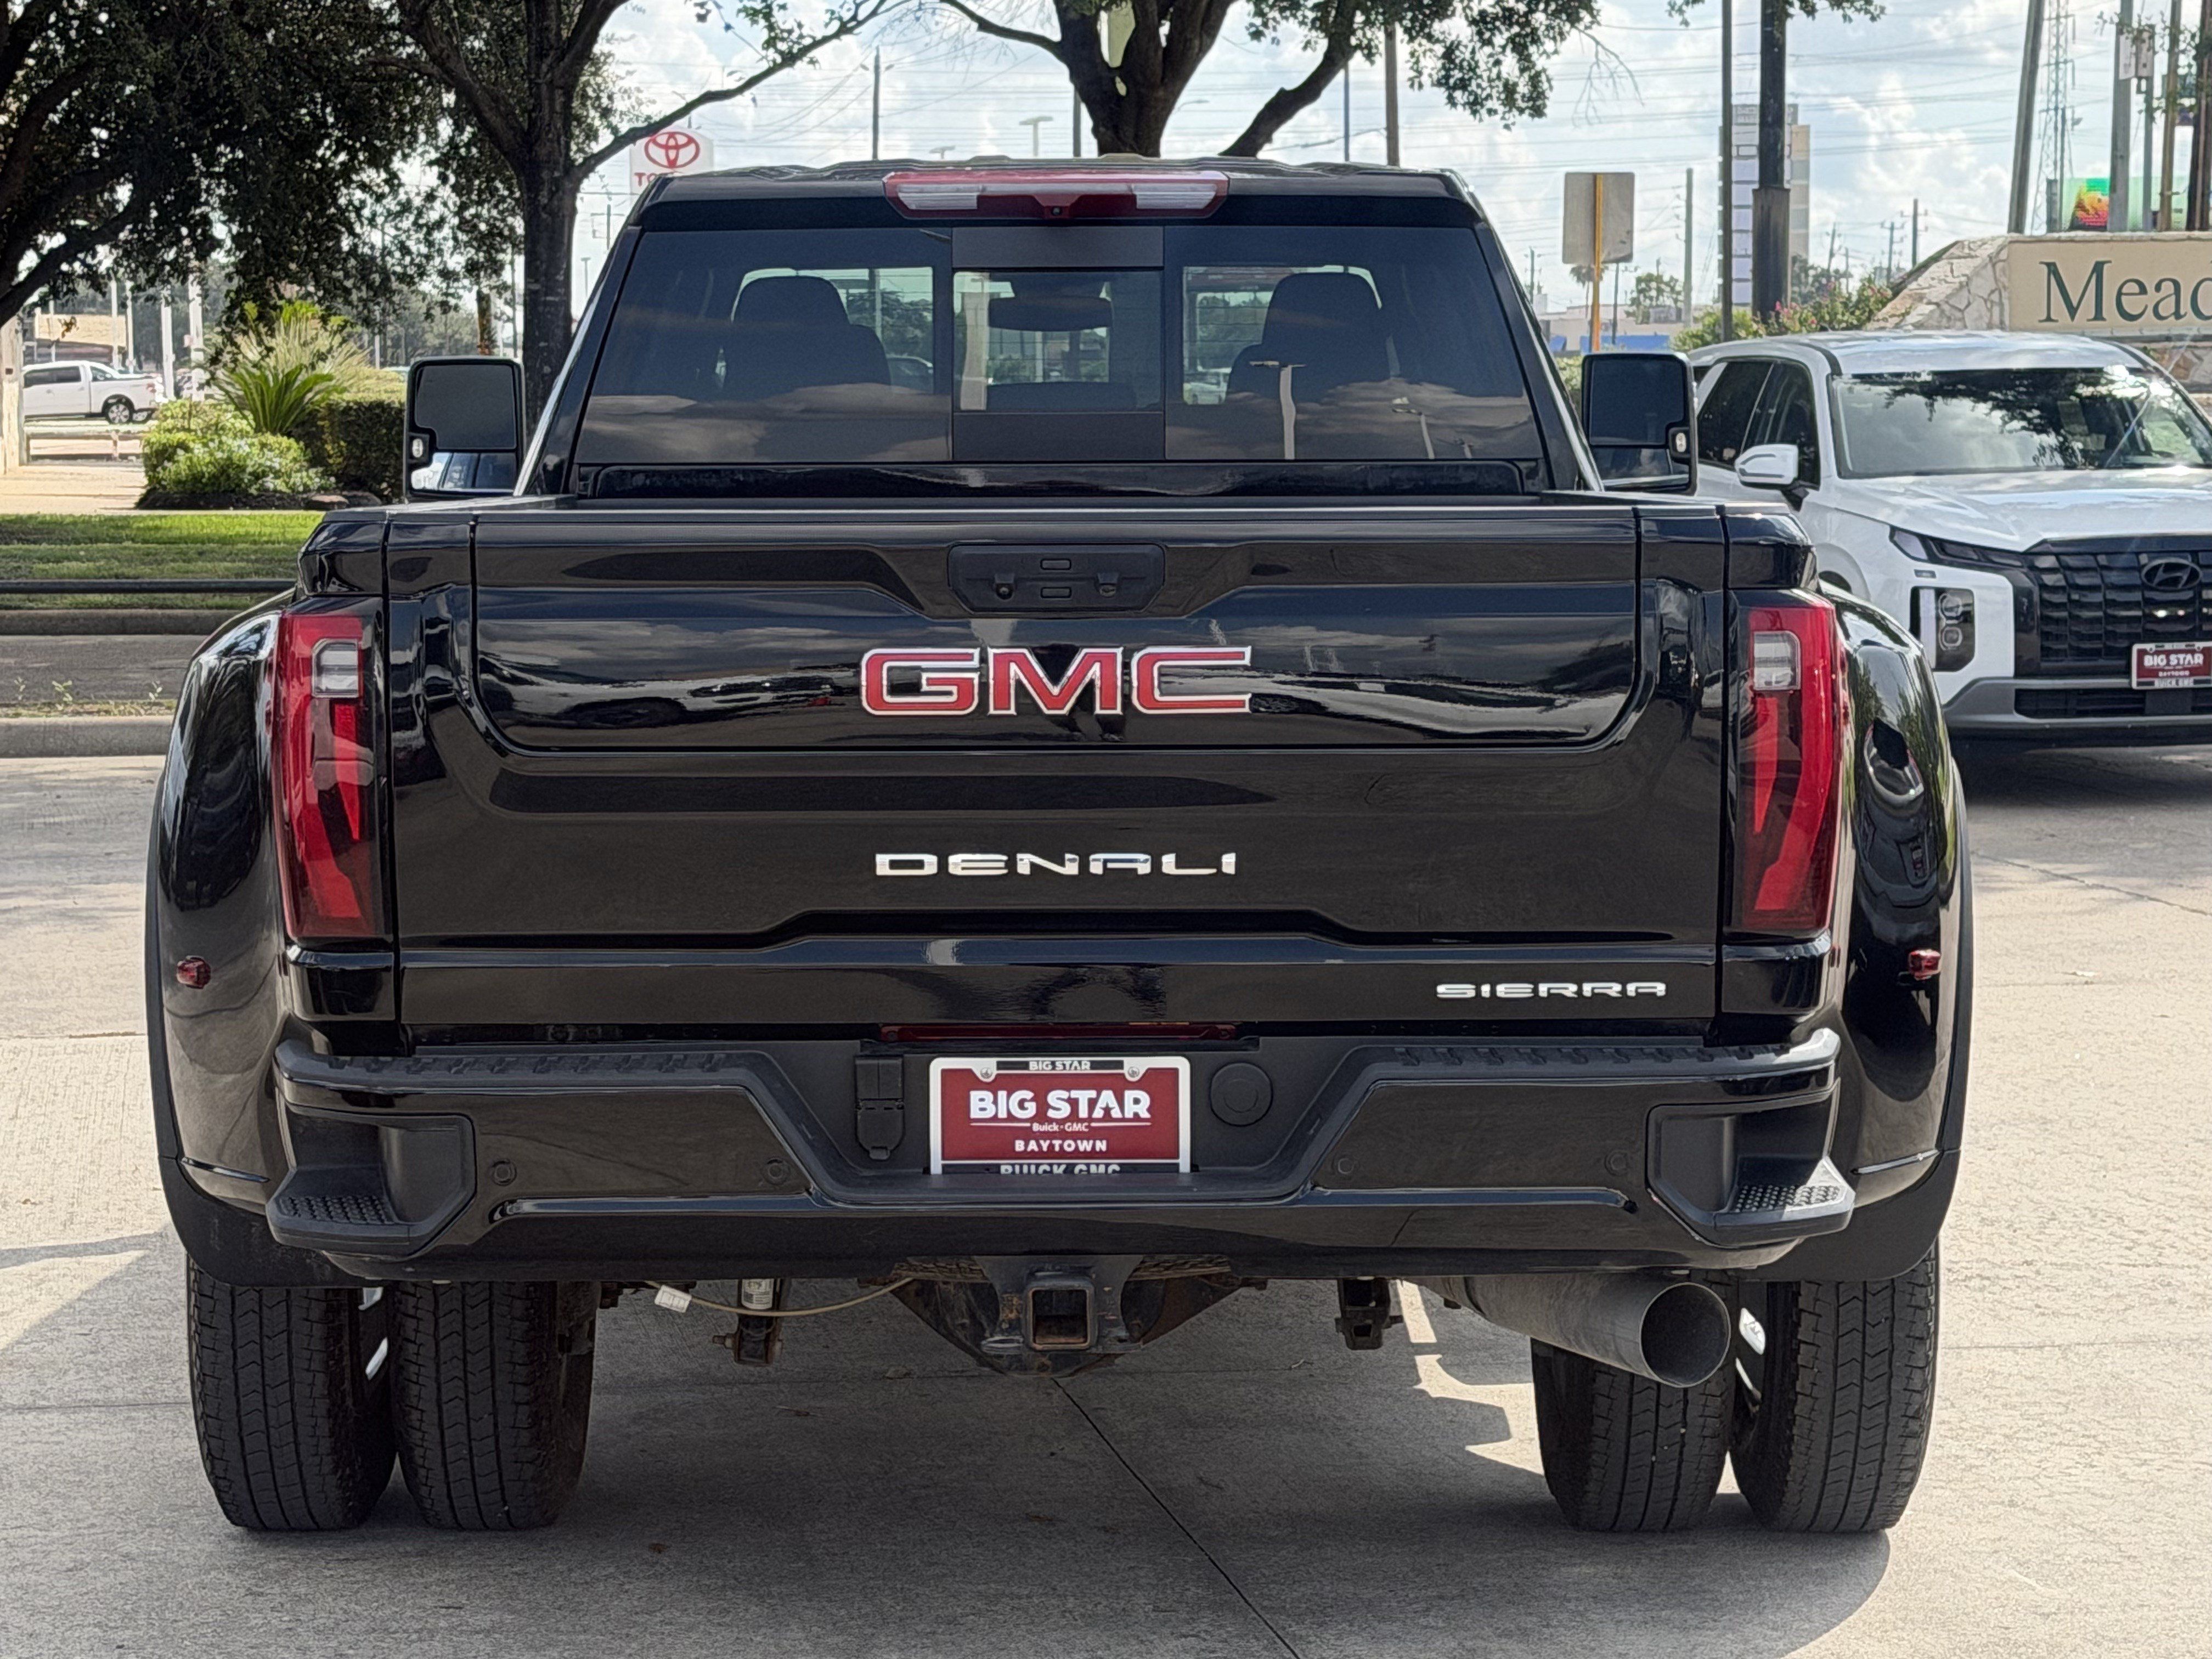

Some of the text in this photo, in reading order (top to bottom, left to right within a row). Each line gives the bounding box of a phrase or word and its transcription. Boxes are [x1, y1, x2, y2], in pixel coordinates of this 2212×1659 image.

[2143, 653, 2204, 666] BIG STAR
[861, 645, 1252, 715] GMC
[875, 852, 1236, 876] DENALI
[1436, 981, 1666, 998] SIERRA
[1029, 1060, 1091, 1070] BIG STAR
[969, 1090, 1151, 1119] BIG STAR
[1015, 1139, 1107, 1152] BAYTOWN
